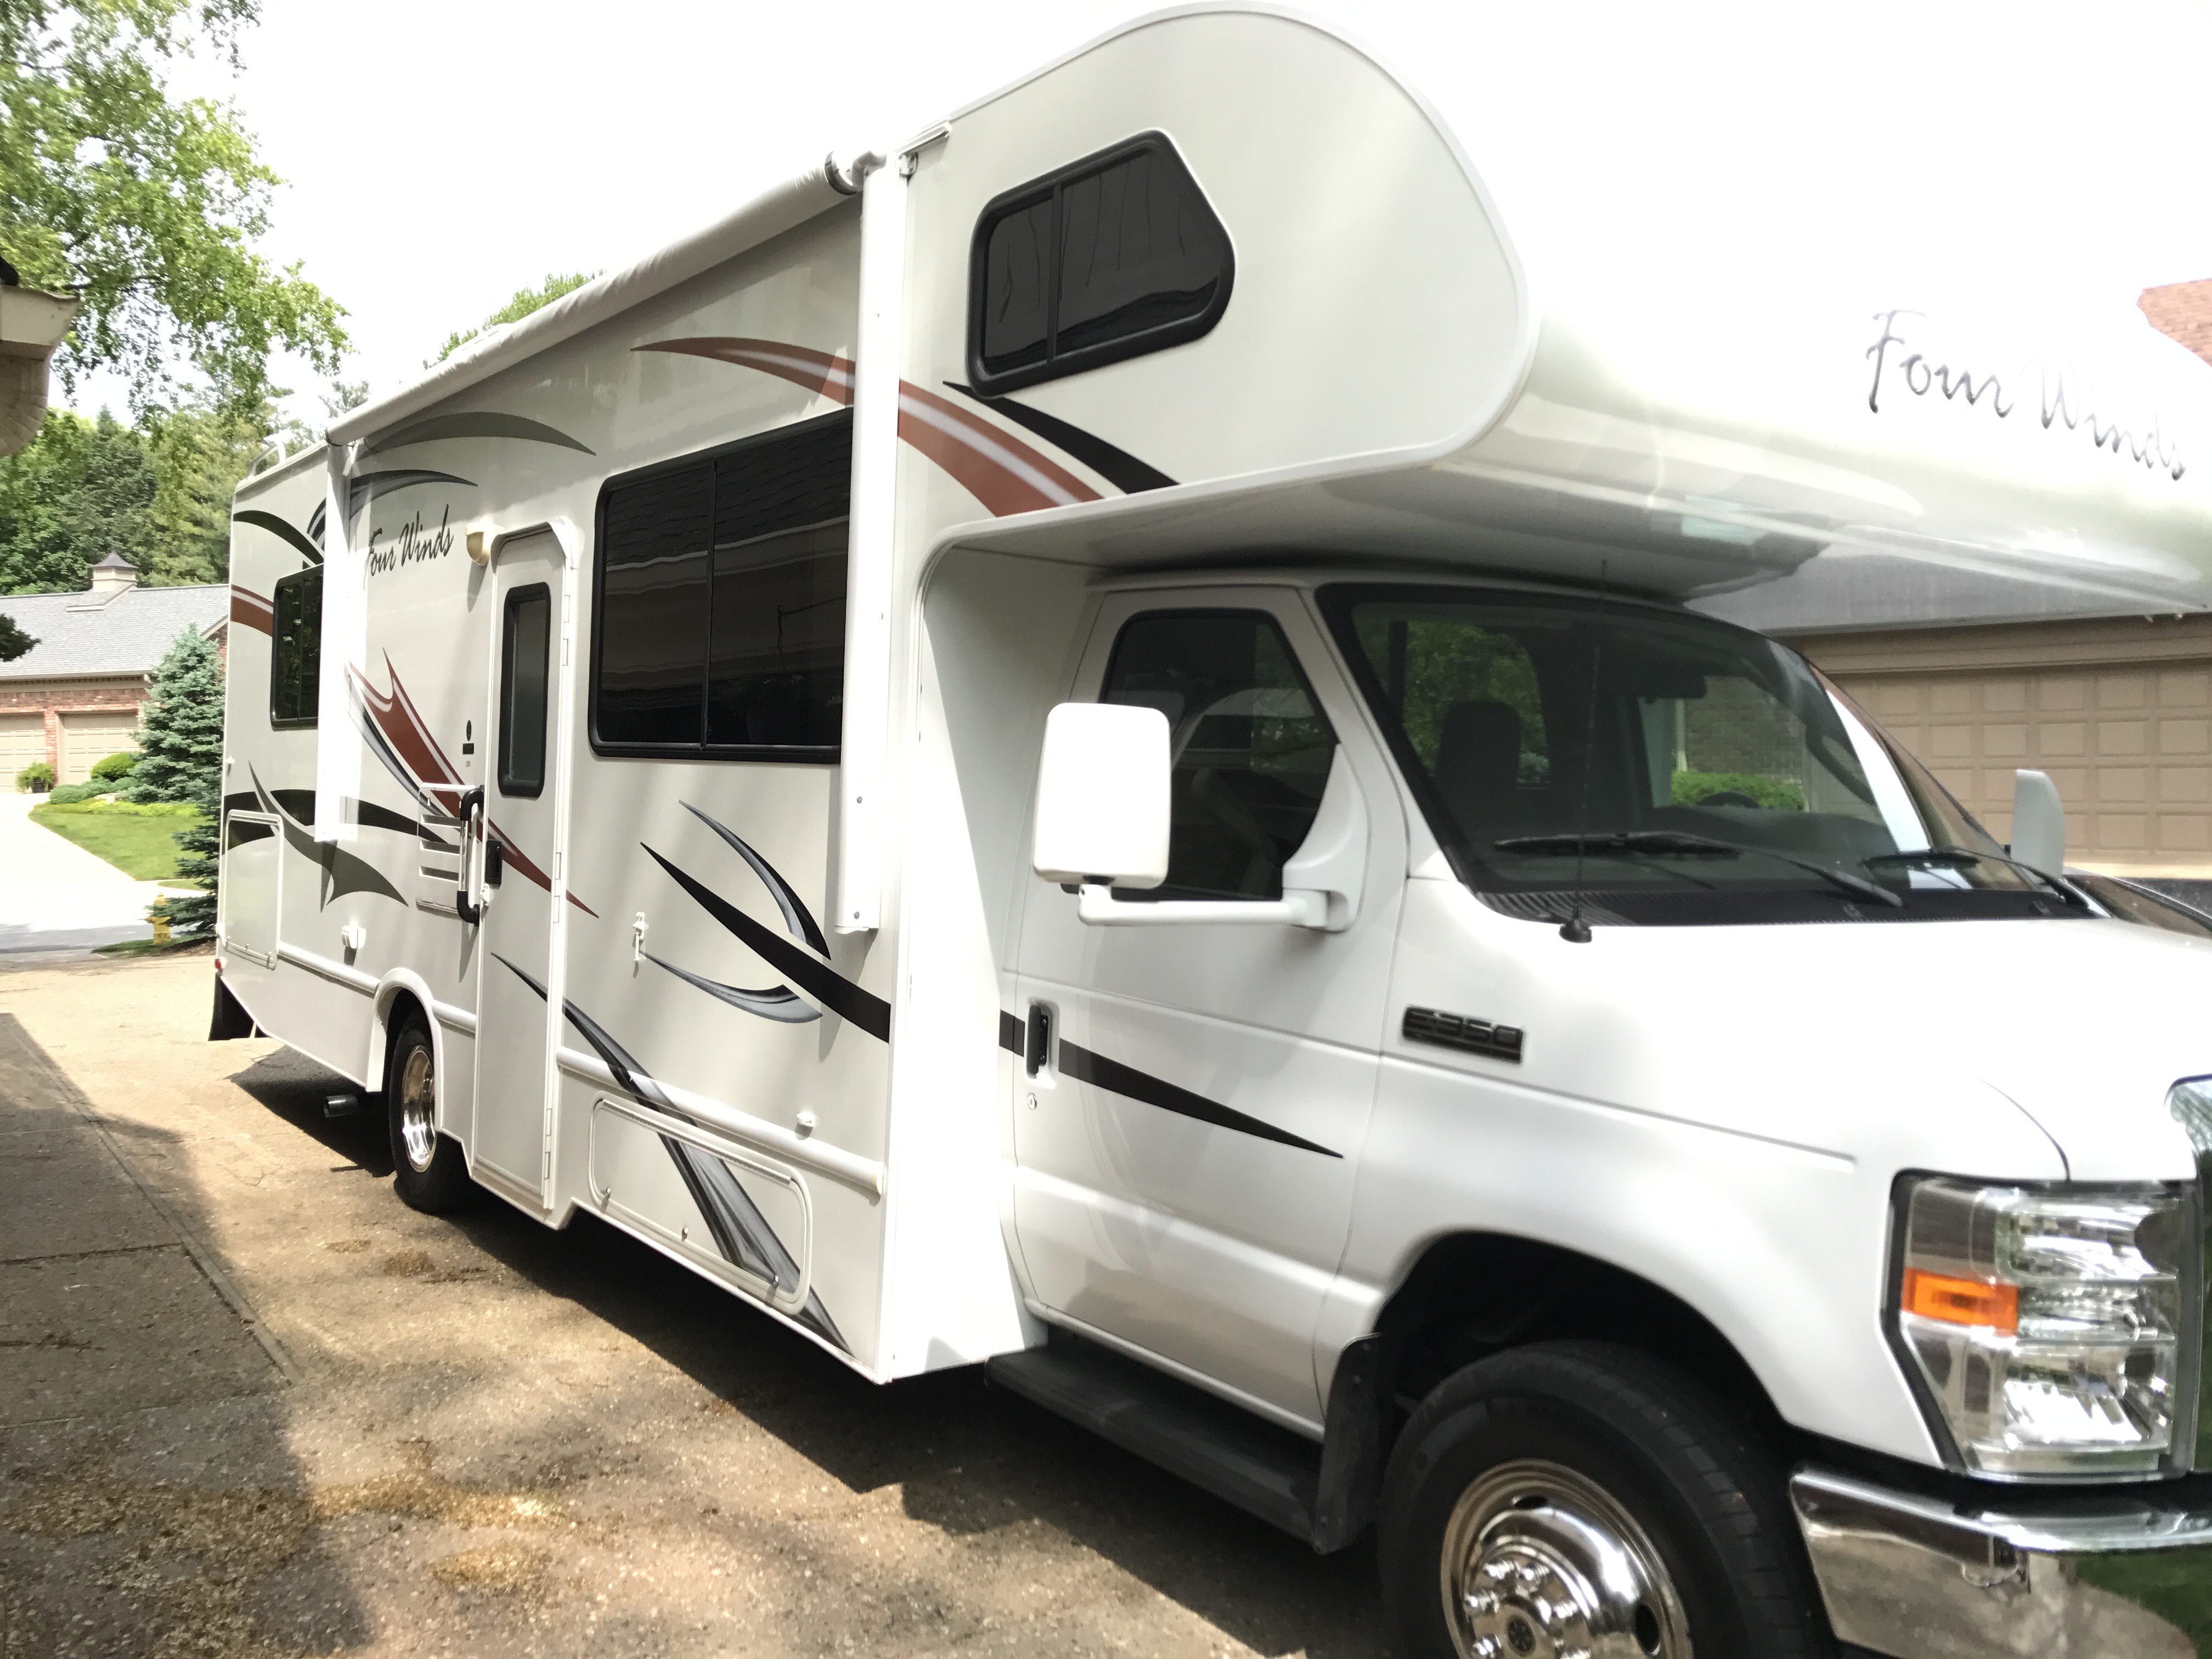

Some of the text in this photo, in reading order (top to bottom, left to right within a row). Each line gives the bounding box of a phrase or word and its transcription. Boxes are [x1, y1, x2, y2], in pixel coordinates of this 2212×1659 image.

[1865, 308, 2186, 482] Four Winds
[363, 504, 454, 590] Four Winds
[1401, 1005, 1523, 1050] E350
